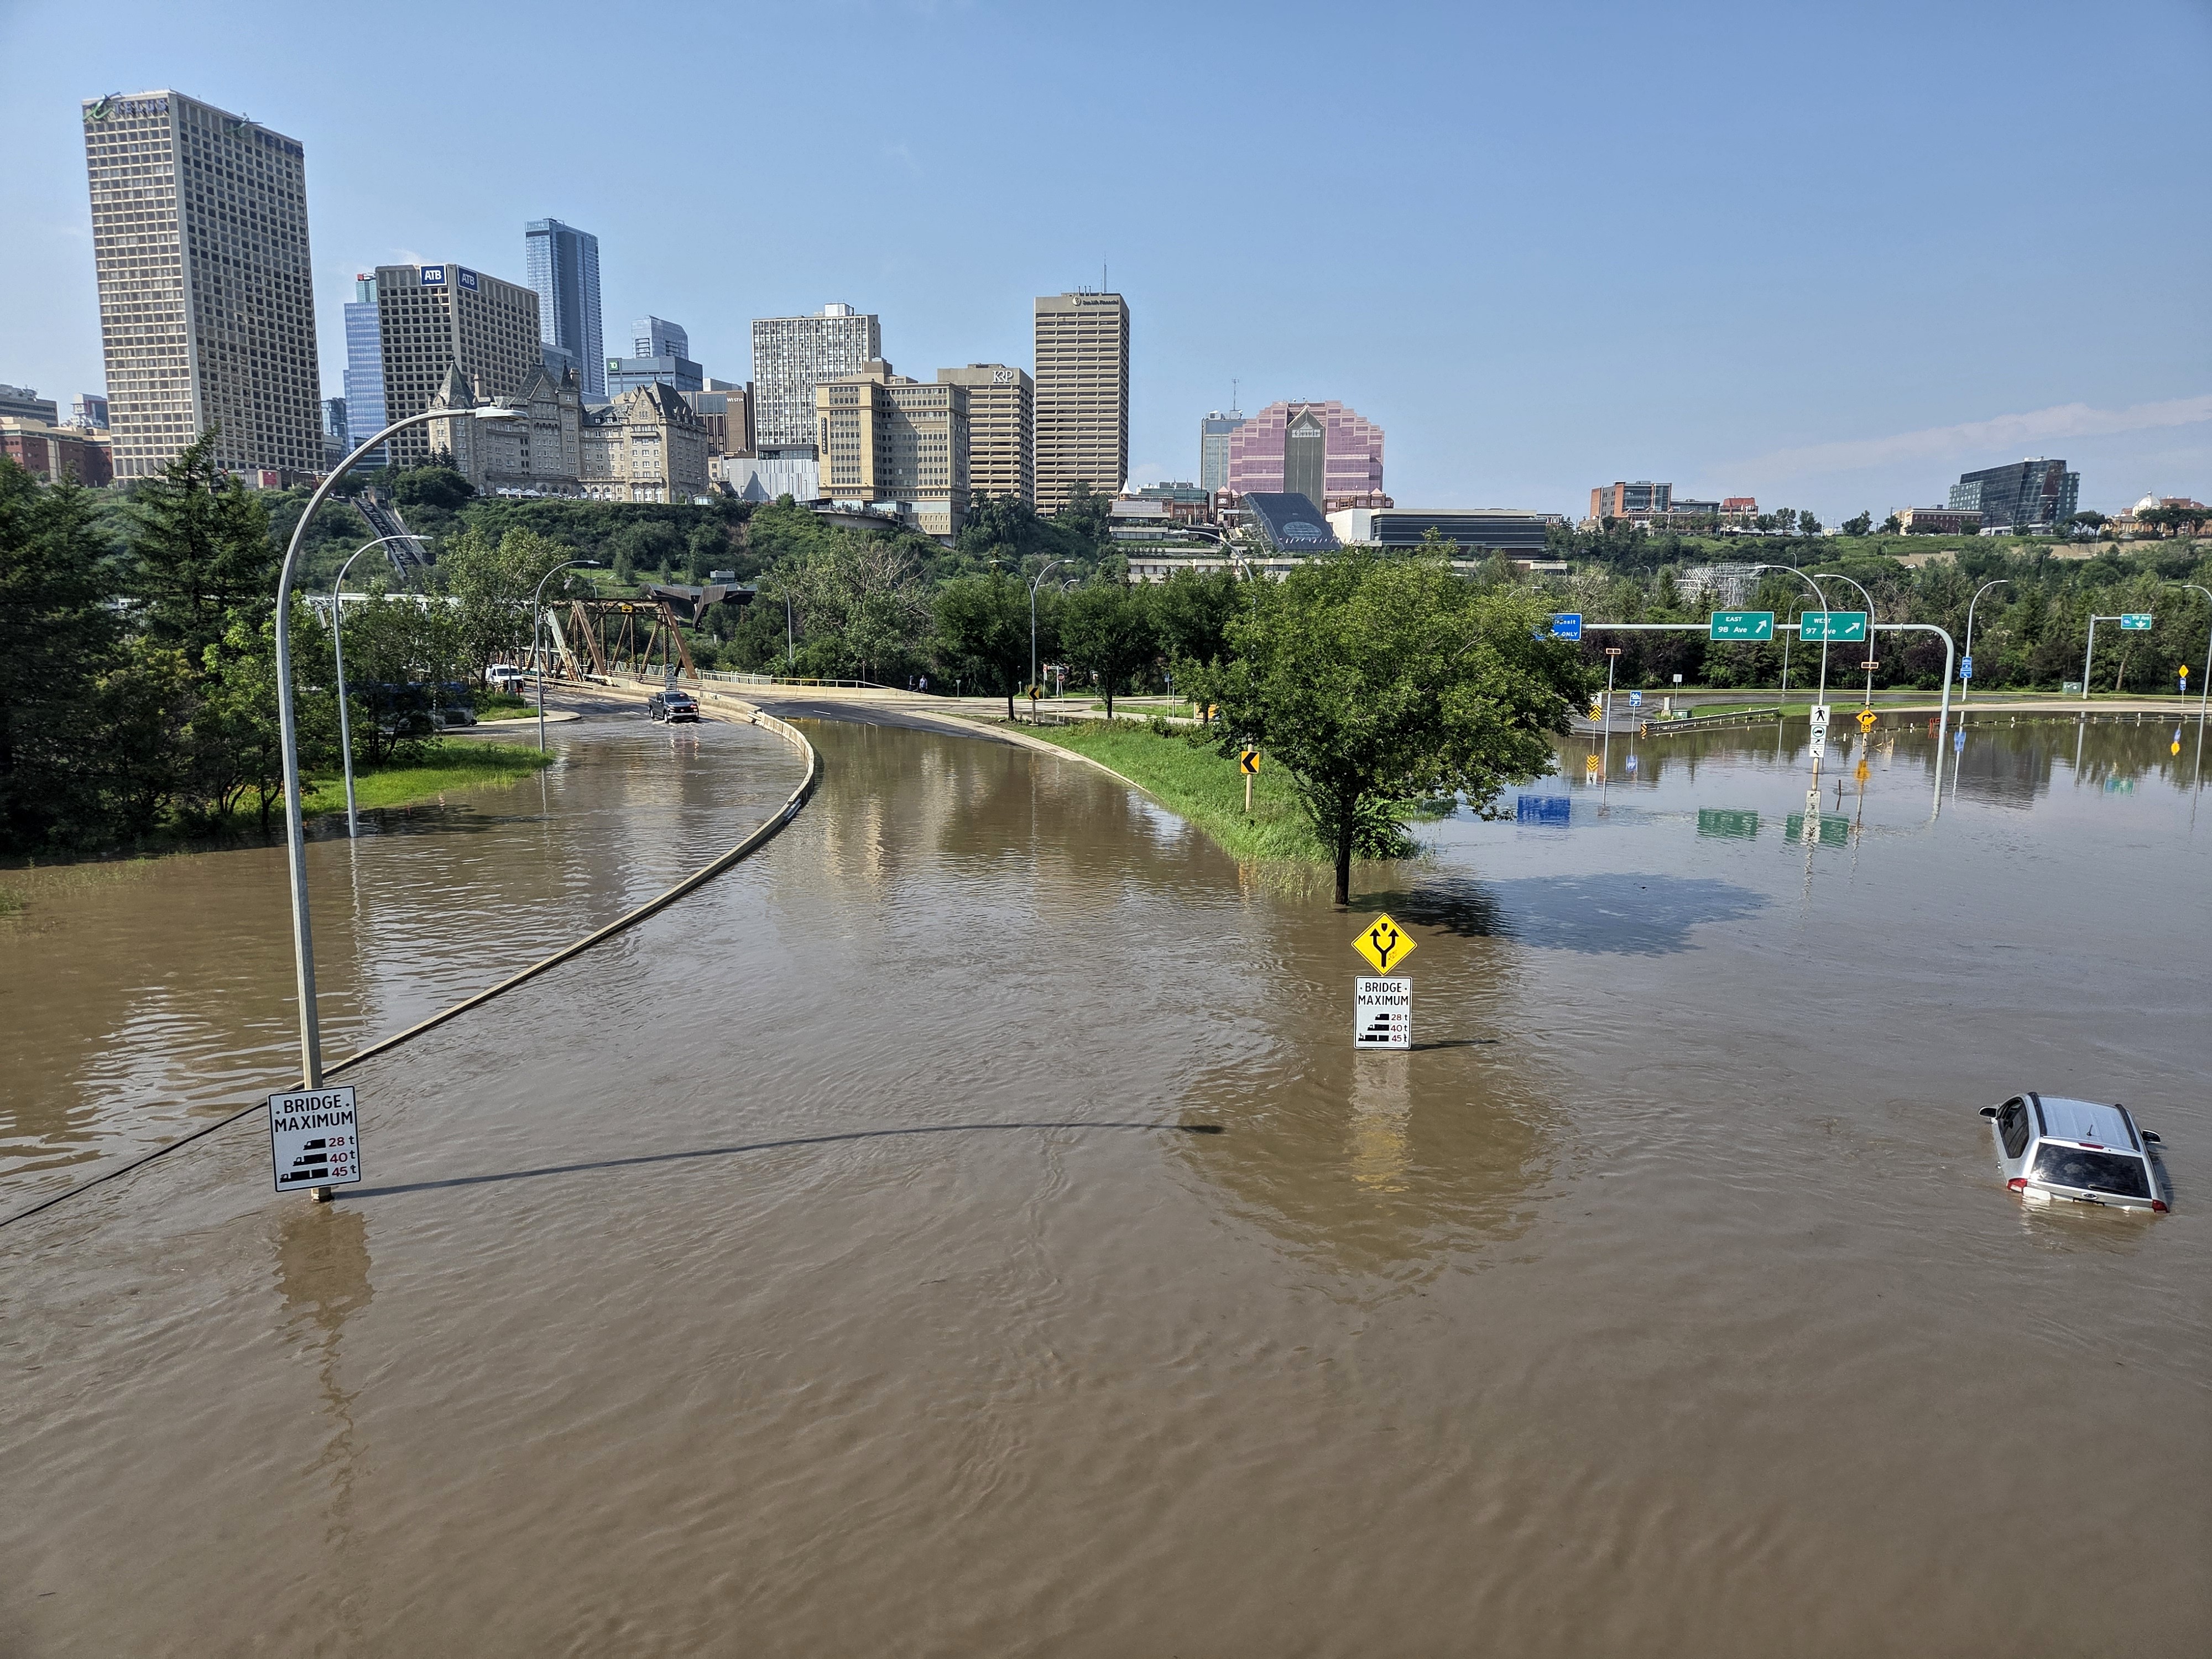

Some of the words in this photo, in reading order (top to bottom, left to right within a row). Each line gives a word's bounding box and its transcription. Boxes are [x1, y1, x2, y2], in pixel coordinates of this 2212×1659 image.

[114, 98, 167, 114] TELUS
[425, 270, 442, 280] ATB
[462, 273, 475, 285] ATB
[992, 370, 1013, 383] KRP
[1365, 982, 1402, 992] BRIDGE
[1358, 995, 1408, 1005] MAXIMUM
[1404, 1034, 1407, 1042] t
[284, 1094, 342, 1114] BRIDGE
[274, 1111, 353, 1133] MAXIMUM
[328, 1137, 345, 1147] 28
[348, 1135, 355, 1145] t
[330, 1152, 348, 1164] 40
[349, 1150, 356, 1159] t
[332, 1166, 348, 1177] 45
[350, 1165, 357, 1174] t
